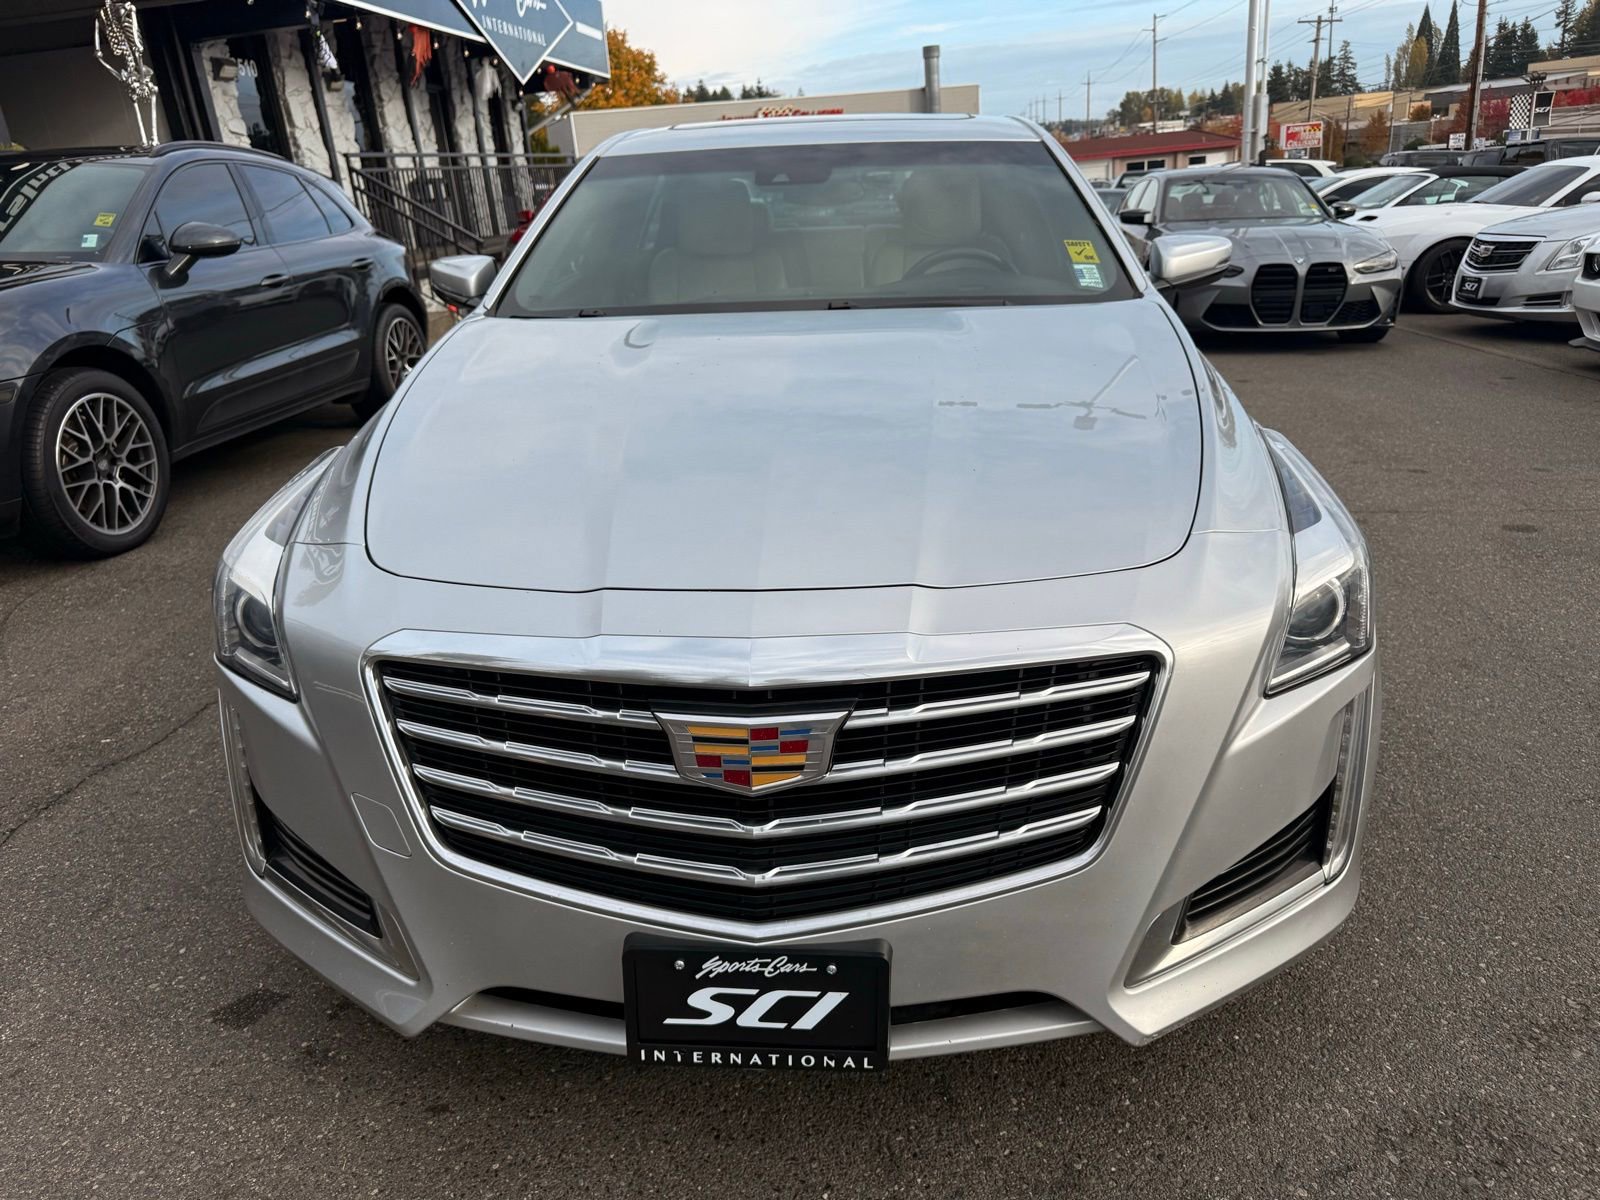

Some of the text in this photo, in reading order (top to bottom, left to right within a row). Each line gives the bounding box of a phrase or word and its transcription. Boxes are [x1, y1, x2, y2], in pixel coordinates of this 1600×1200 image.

[481, 15, 547, 47] INTERNATIONAL
[231, 57, 258, 78] 510
[694, 955, 818, 980] Sports Cars
[662, 986, 850, 1030] SCI
[640, 1049, 874, 1069] INTERNATIONAL
